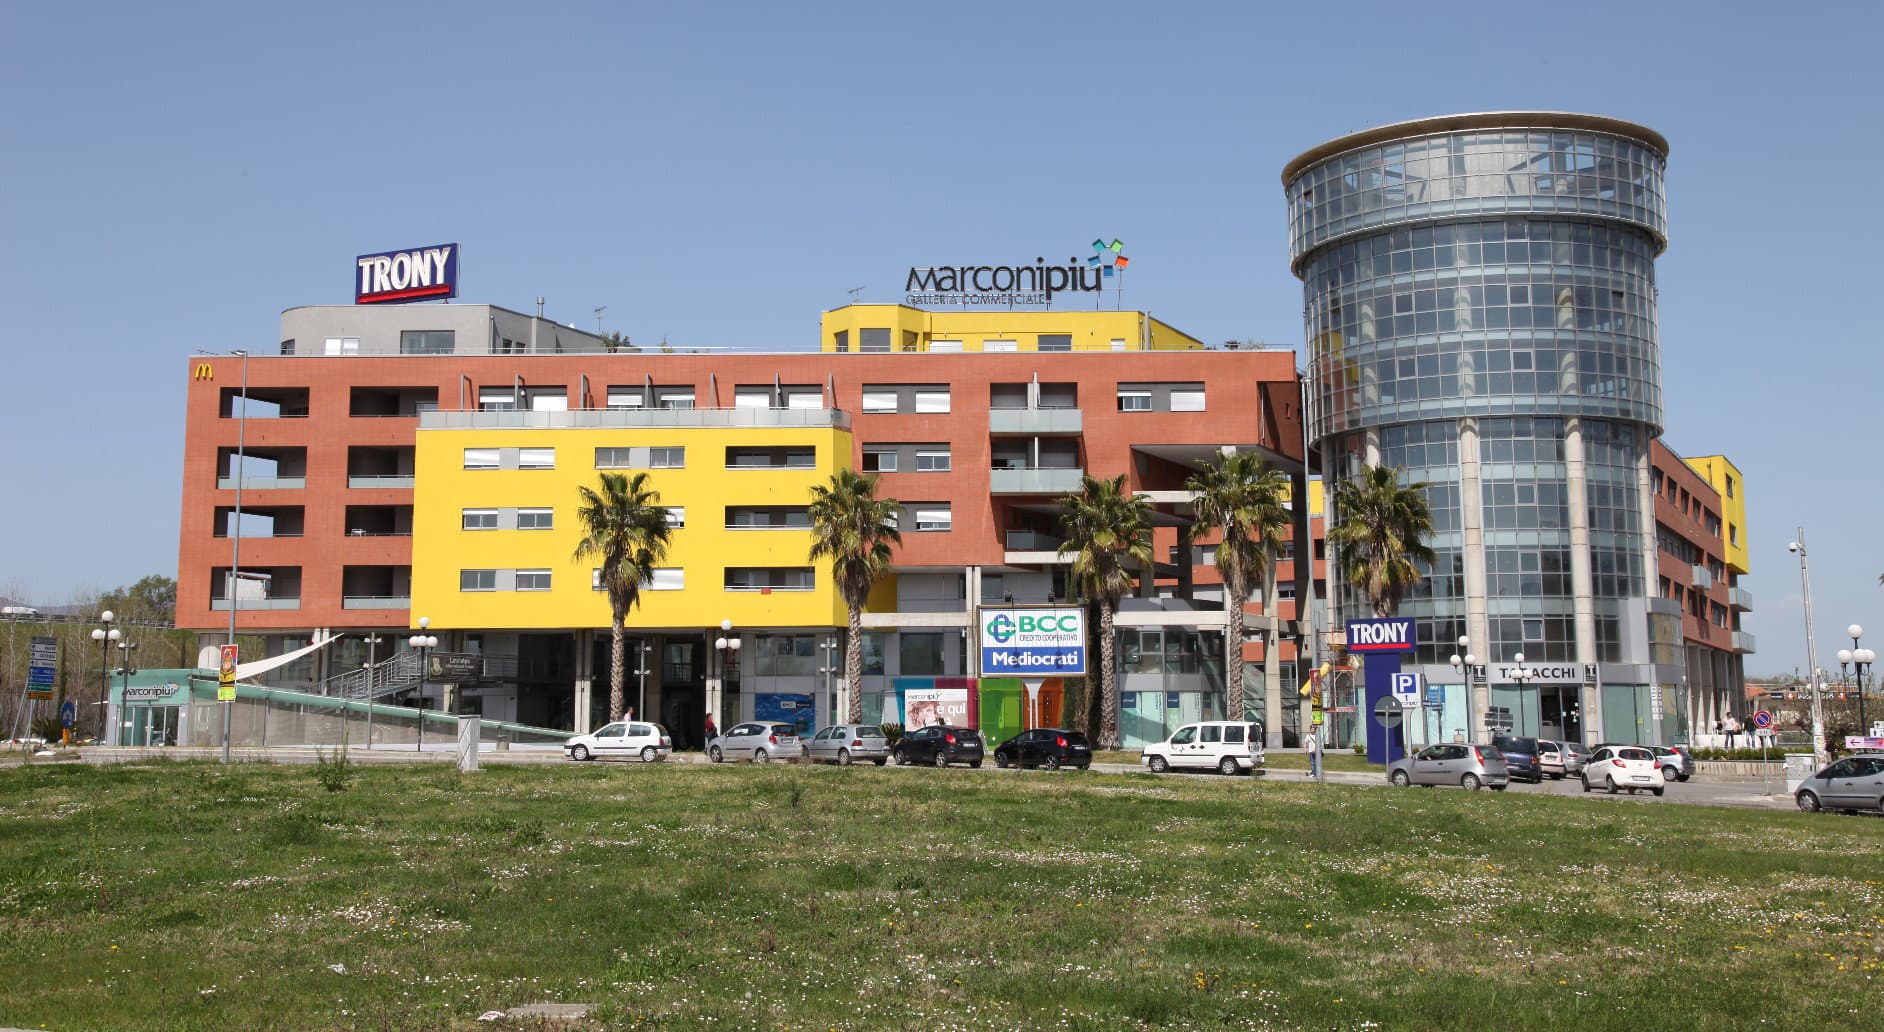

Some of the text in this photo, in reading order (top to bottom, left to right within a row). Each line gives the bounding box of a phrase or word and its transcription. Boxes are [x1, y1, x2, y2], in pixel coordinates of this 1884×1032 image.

[358, 247, 452, 294] TRONY
[906, 294, 1045, 305] GALLERIA COMMERCIALE
[1019, 615, 1078, 632] BCC
[1019, 634, 1078, 642] CREDITO COOPERATIVO
[1350, 622, 1409, 644] TRONY
[992, 650, 1078, 666] Mediocrati
[1499, 667, 1575, 679] TACCHI
[947, 702, 966, 717] qui
